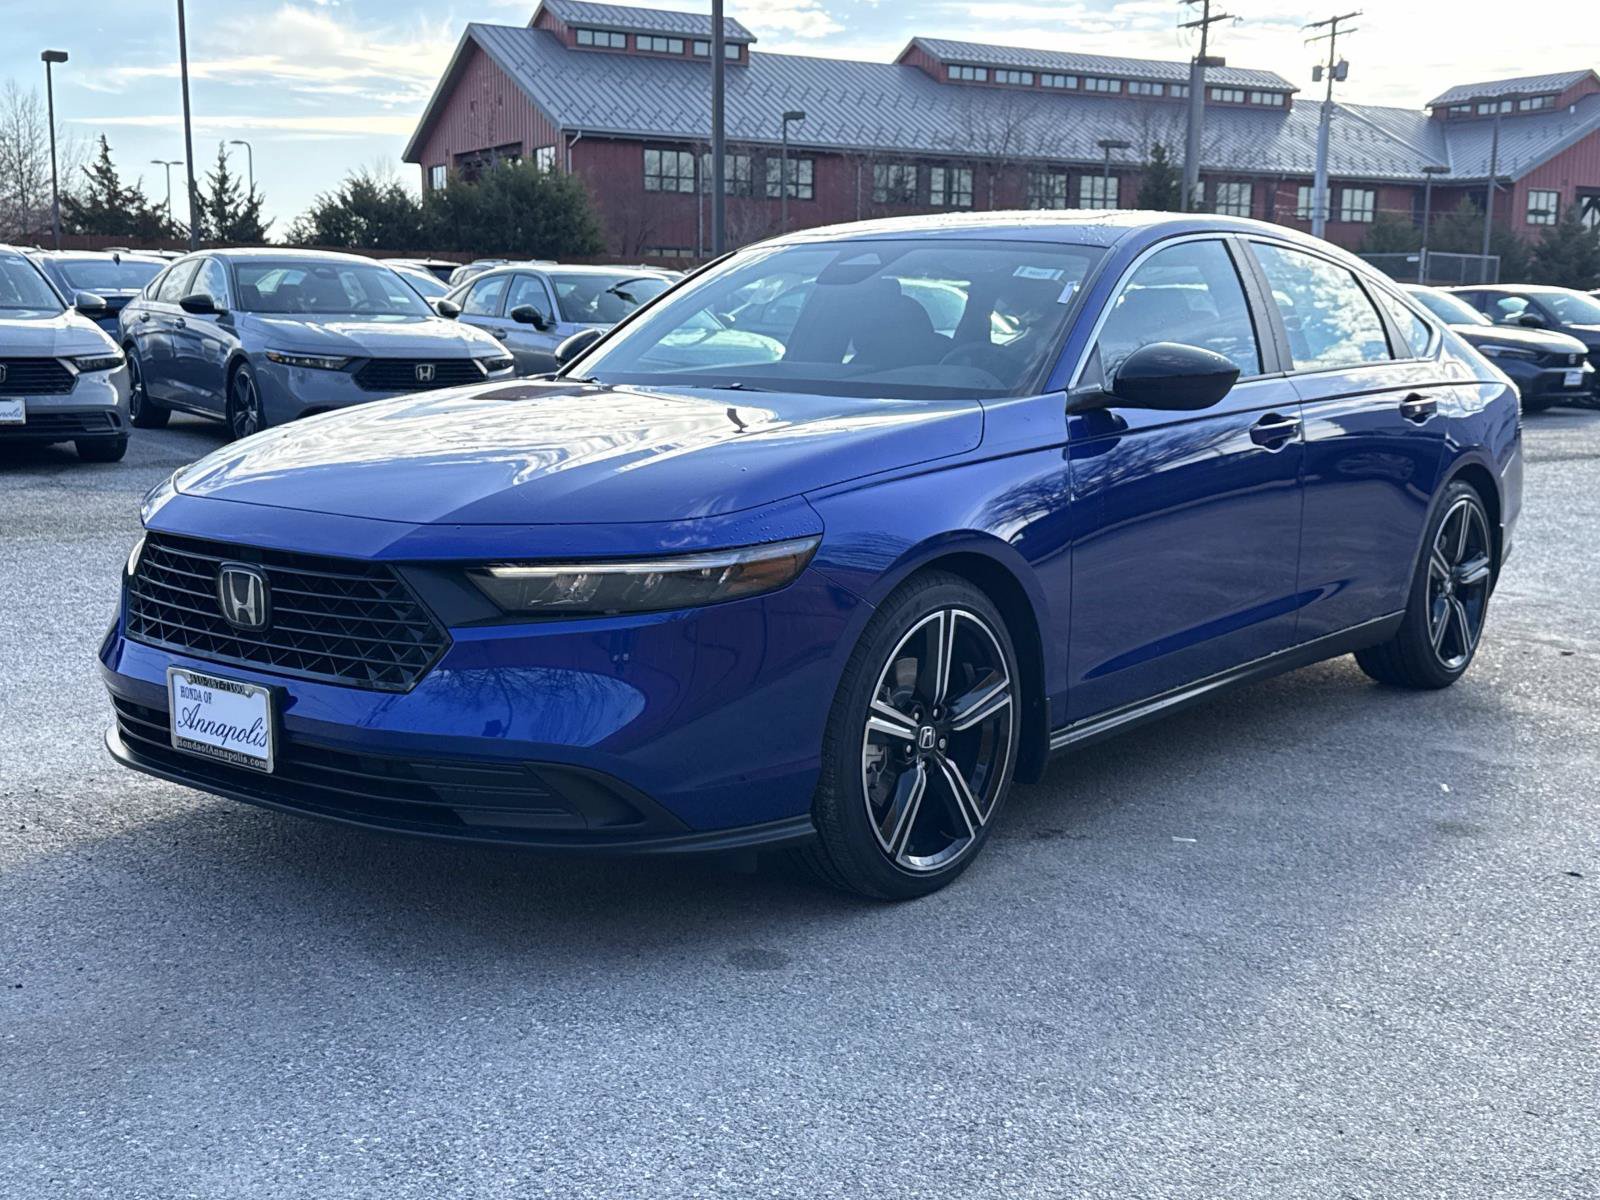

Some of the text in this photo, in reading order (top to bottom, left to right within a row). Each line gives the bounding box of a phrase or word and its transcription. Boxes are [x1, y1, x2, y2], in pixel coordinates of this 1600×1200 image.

[180, 685, 212, 704] HONDA OF
[177, 703, 268, 748] Annapolis
